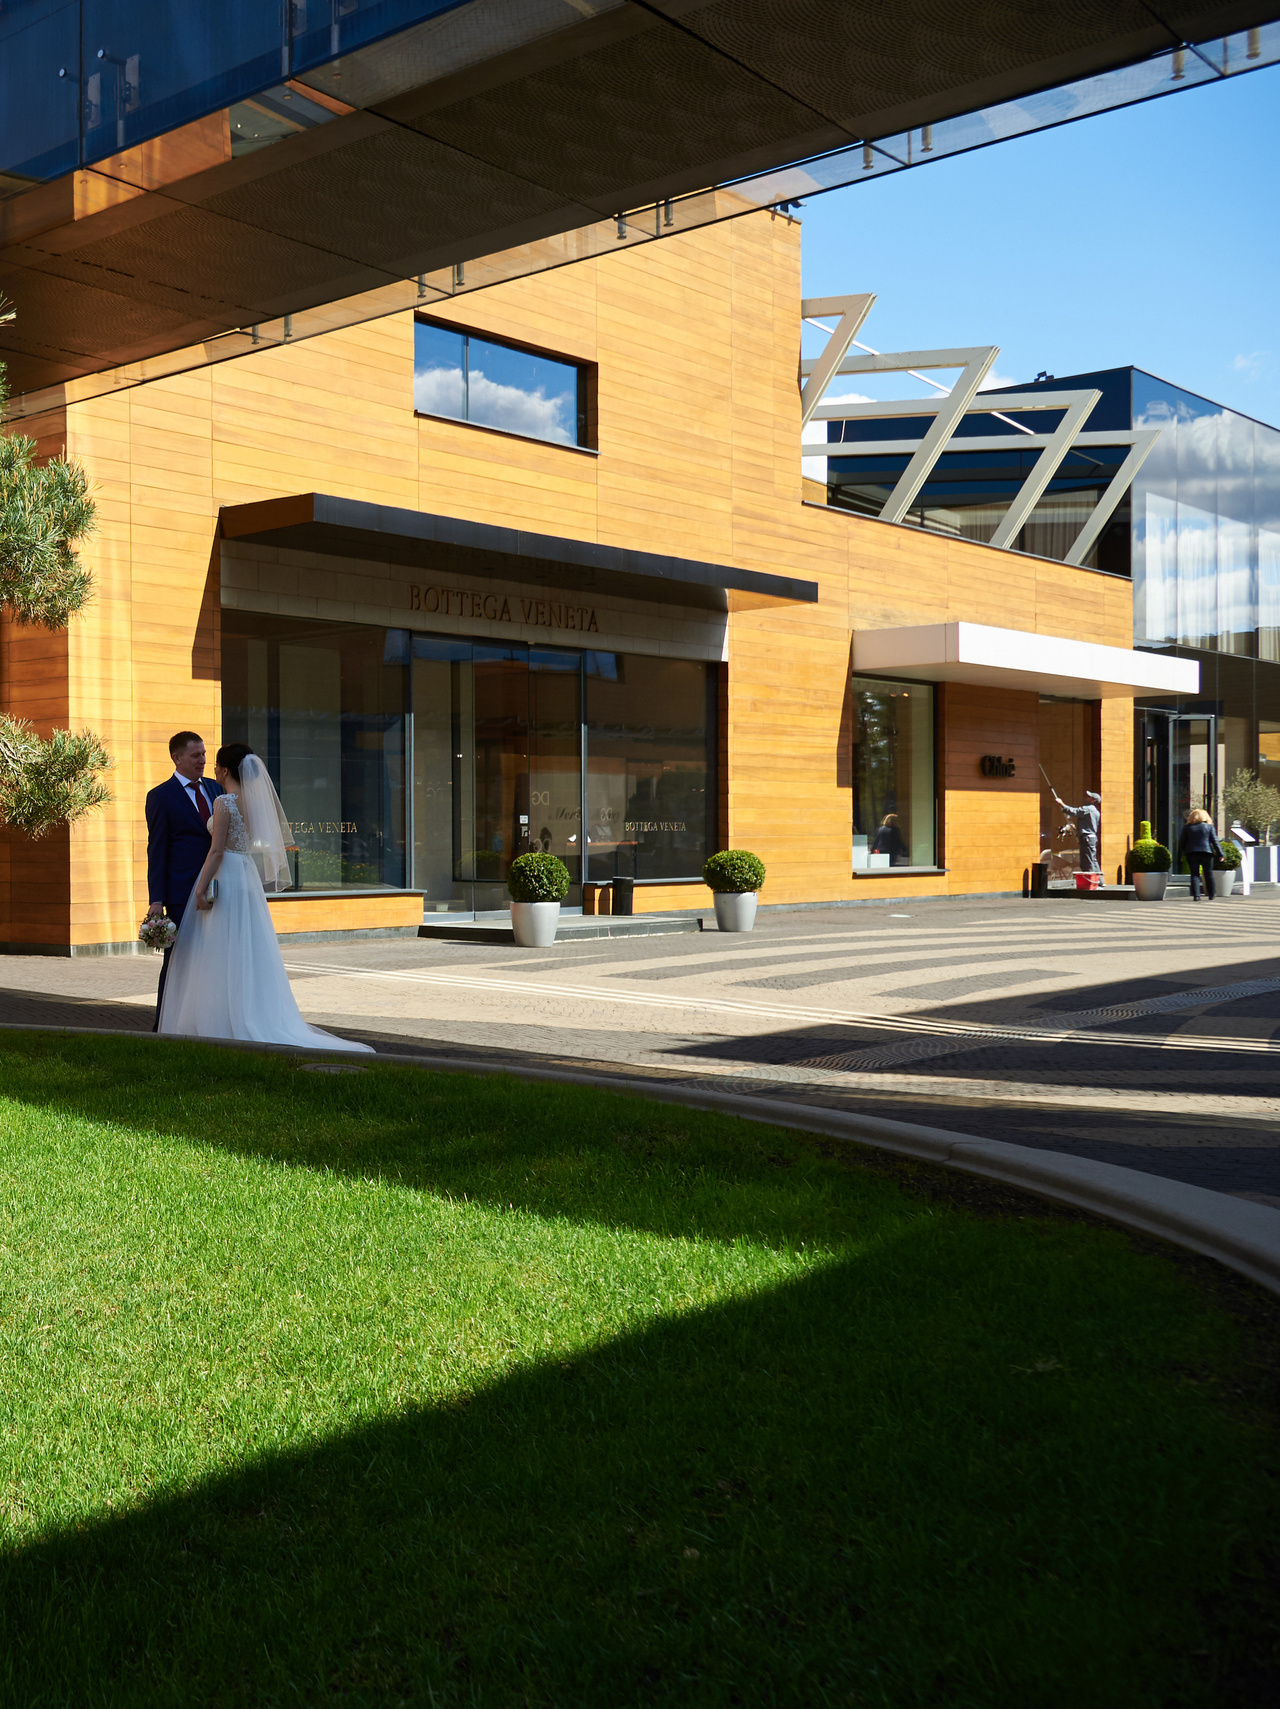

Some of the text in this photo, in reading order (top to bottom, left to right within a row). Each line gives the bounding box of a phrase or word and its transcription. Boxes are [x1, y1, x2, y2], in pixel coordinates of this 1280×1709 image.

[409, 585, 599, 633] BOTTEGA VENETA
[318, 822, 358, 834] VENETA
[624, 821, 686, 832] BOTTEGA VENETA
